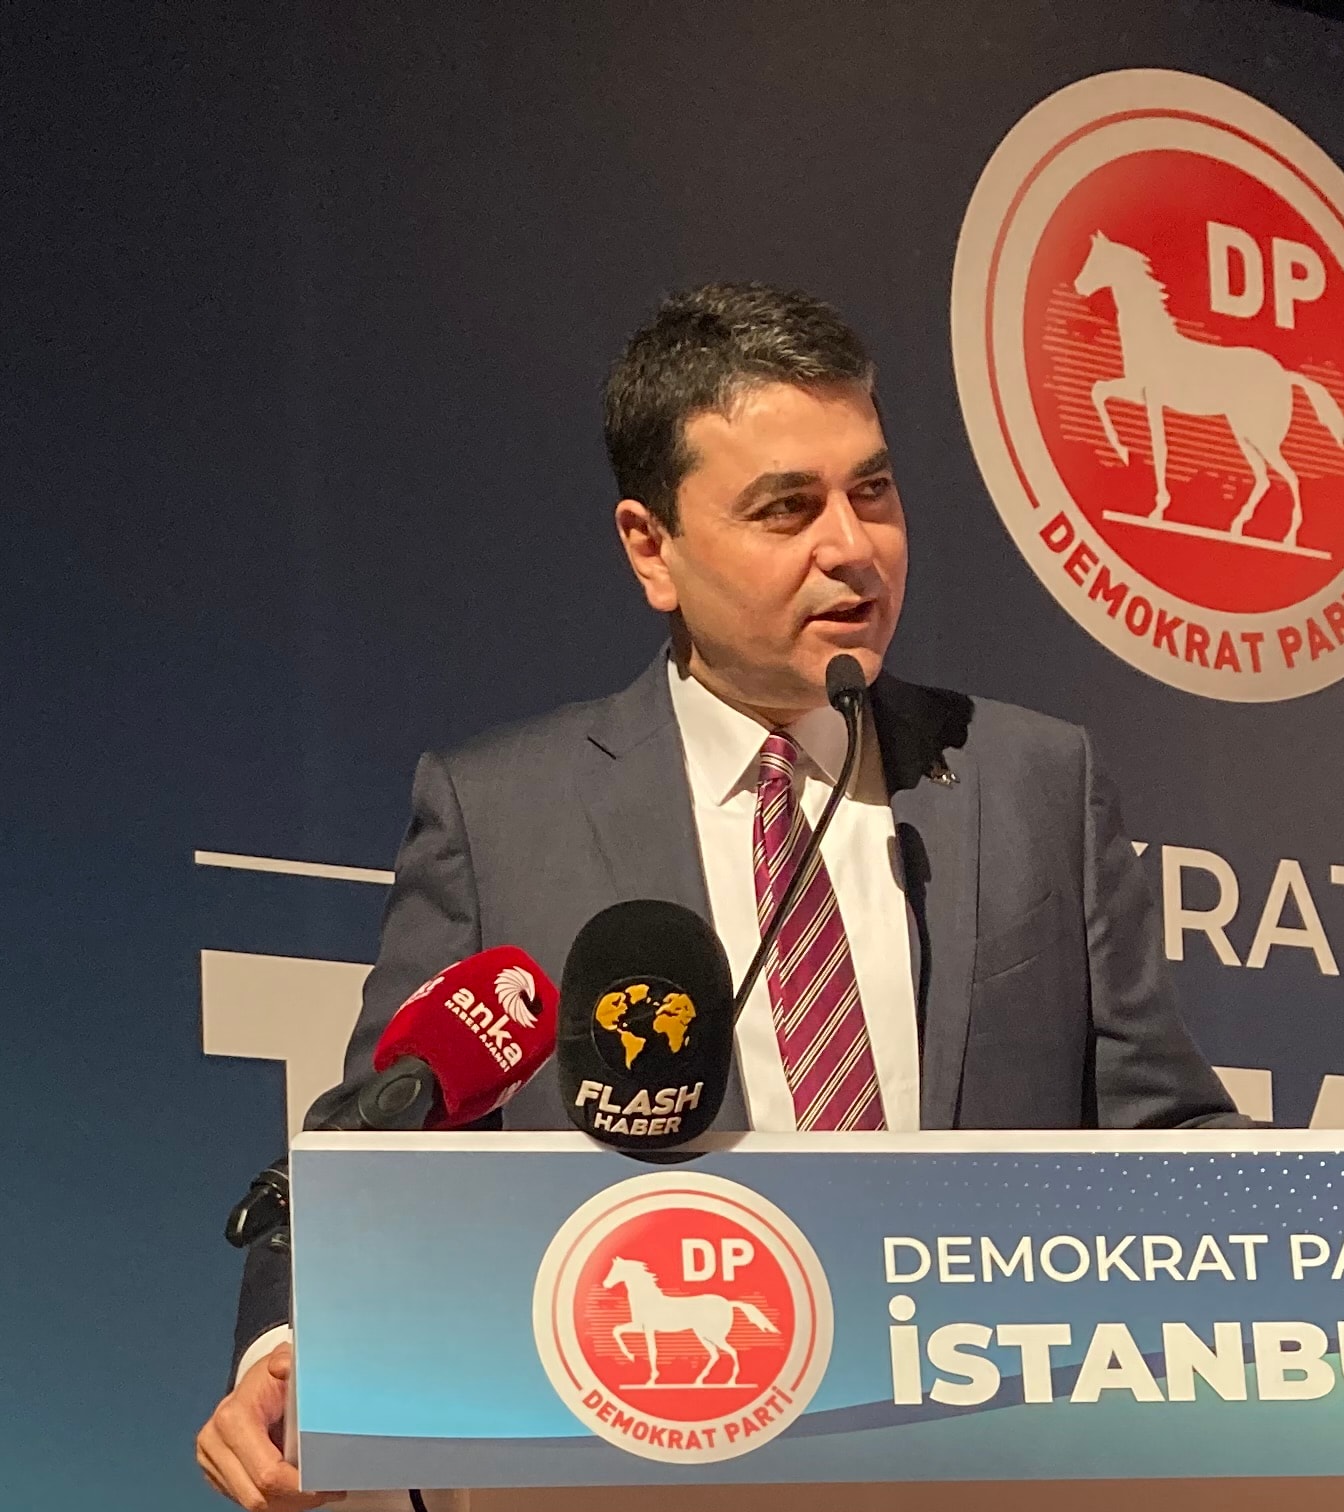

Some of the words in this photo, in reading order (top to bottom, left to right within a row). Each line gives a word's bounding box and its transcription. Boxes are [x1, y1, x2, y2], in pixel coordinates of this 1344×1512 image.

[1206, 220, 1328, 330] DP
[1039, 510, 1265, 674] DEMOKRAT
[444, 999, 481, 1034] HABER
[452, 987, 523, 1067] anka
[575, 1080, 705, 1116] FLASH
[594, 1112, 682, 1136] HABER
[681, 1238, 755, 1282] DP
[883, 1235, 1269, 1284] DEMOKRAT
[582, 1388, 717, 1450] DEMOKRAT
[723, 1385, 793, 1443] PARTİ
